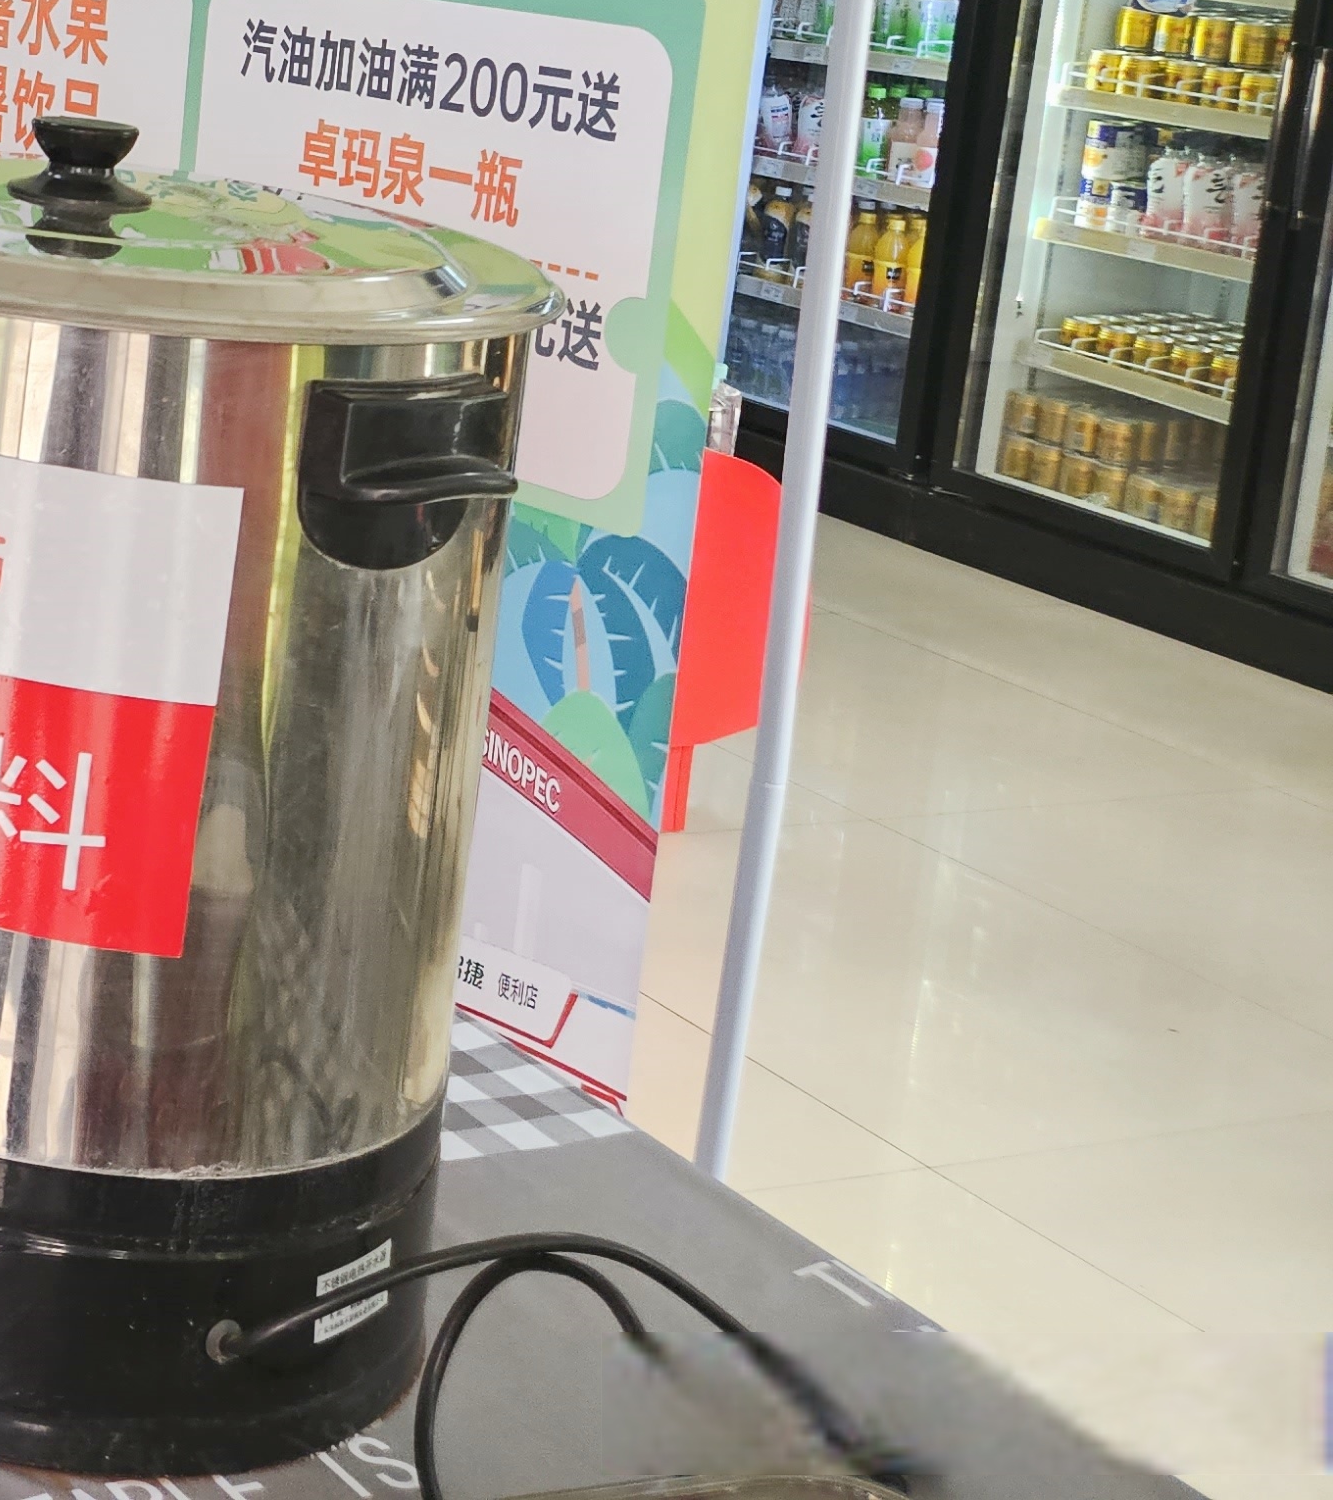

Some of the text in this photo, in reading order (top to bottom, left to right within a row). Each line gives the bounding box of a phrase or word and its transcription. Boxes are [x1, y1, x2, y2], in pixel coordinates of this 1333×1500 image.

[240, 17, 623, 144] 汽油加油满200元送
[296, 118, 525, 229] 卓玛泉一瓶
[496, 968, 539, 1012] 便利店
